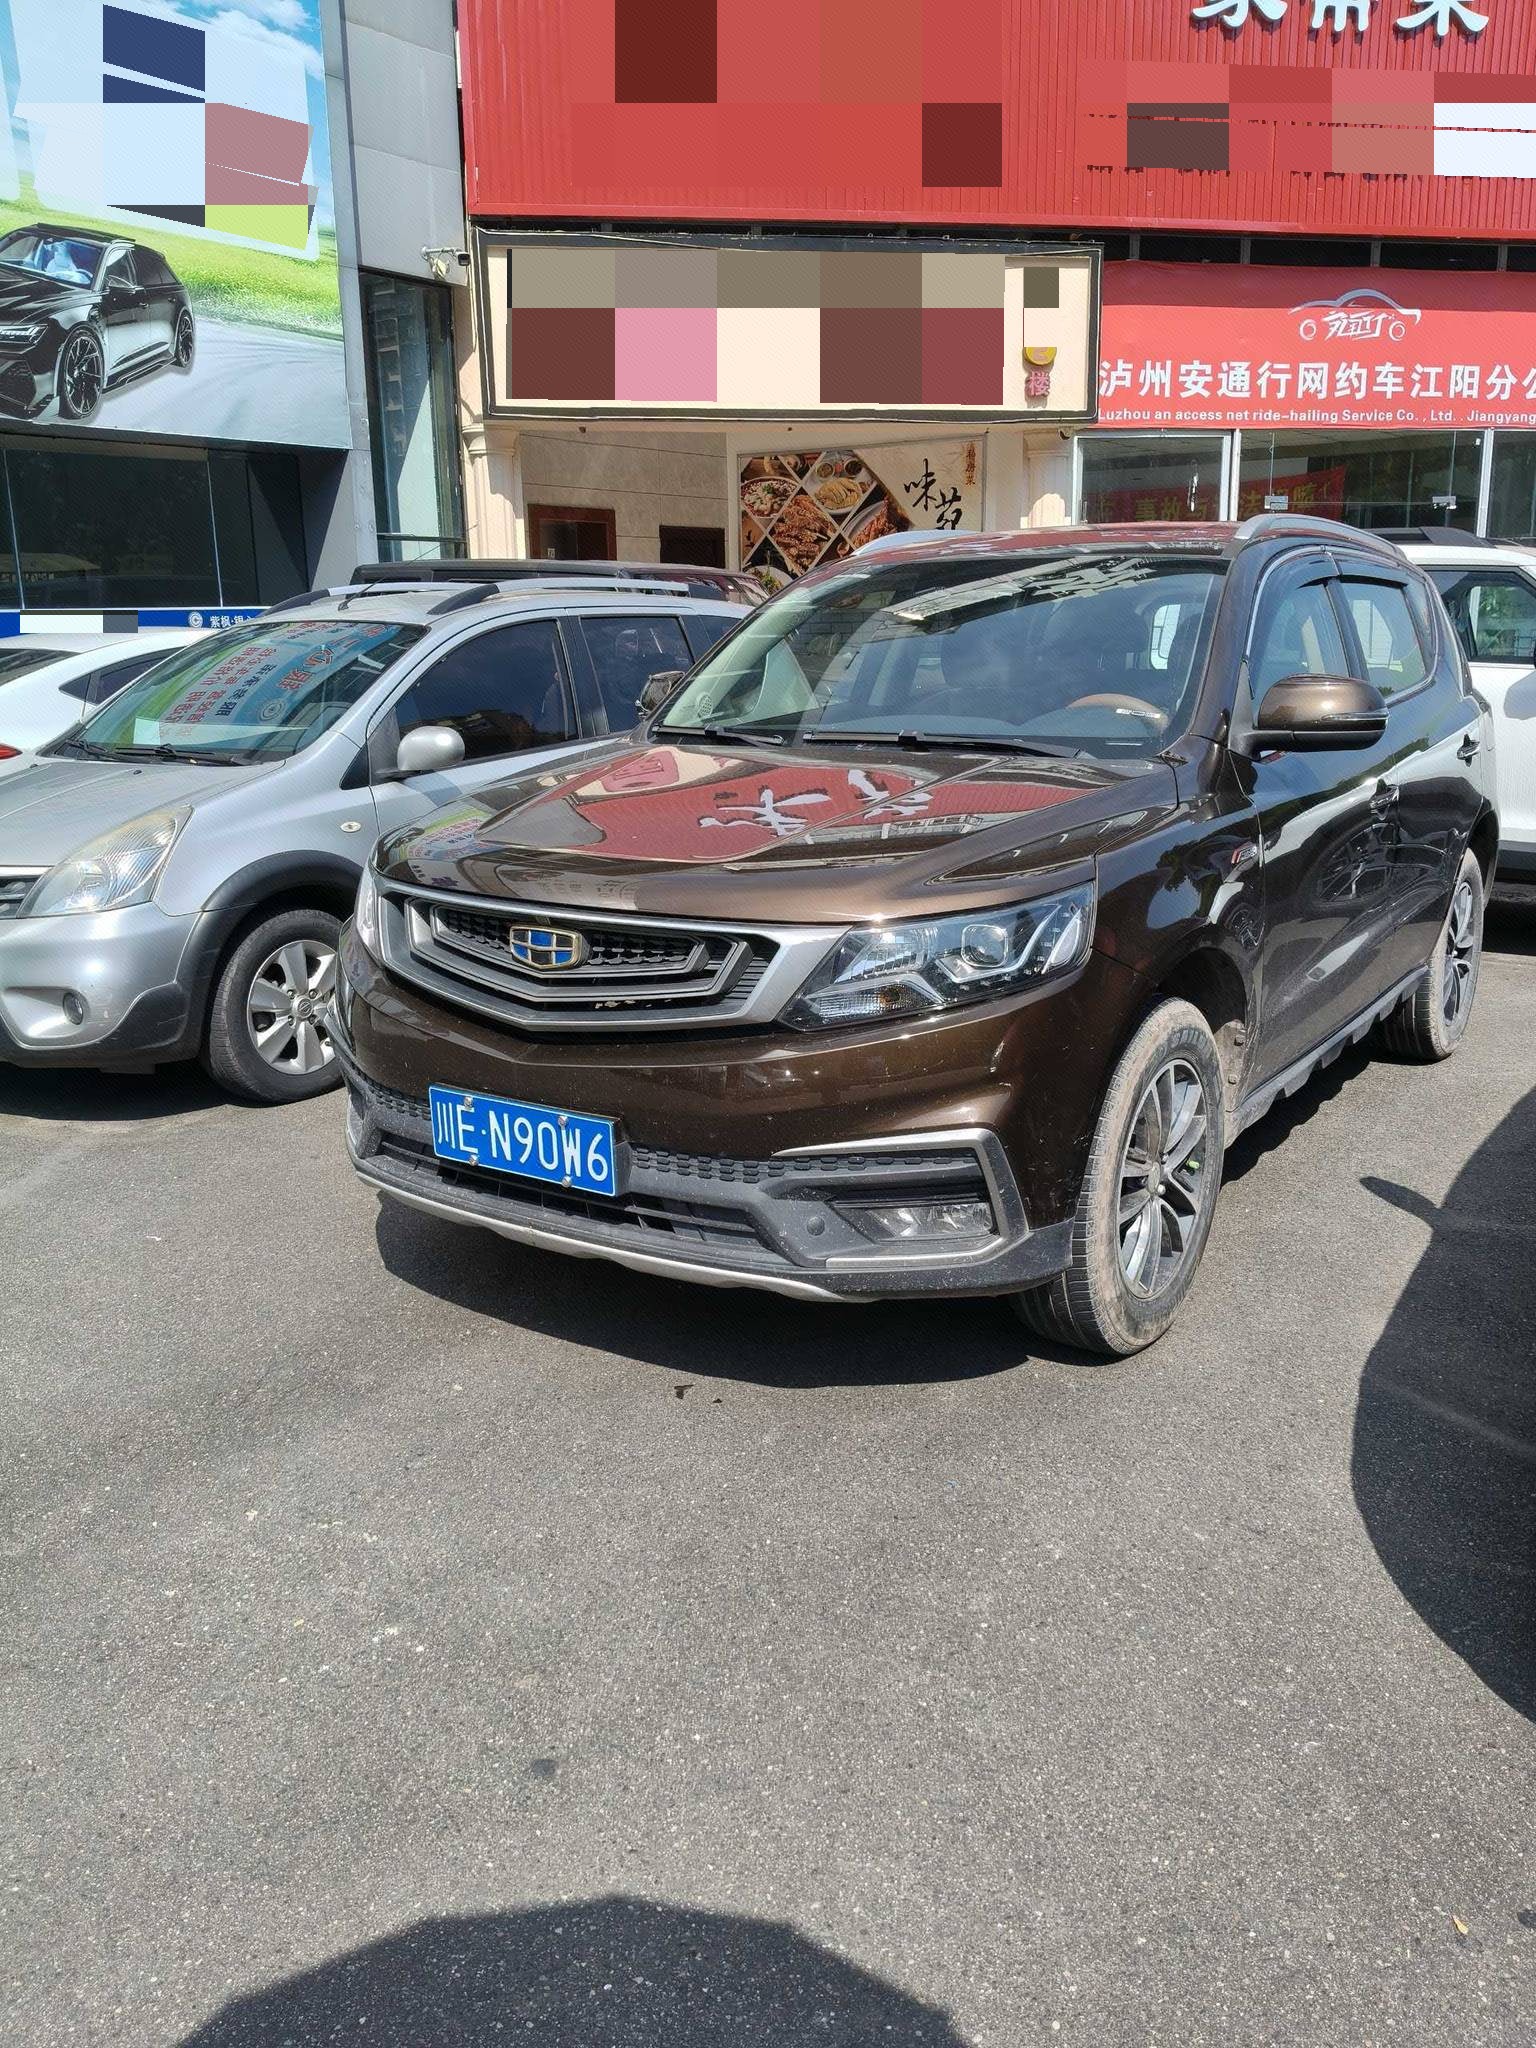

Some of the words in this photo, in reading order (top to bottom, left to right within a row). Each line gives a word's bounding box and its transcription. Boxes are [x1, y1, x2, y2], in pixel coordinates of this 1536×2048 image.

[1155, 411, 1171, 421] an
[1175, 410, 1223, 421] access
[1227, 409, 1249, 421] net
[1341, 409, 1393, 422] Service
